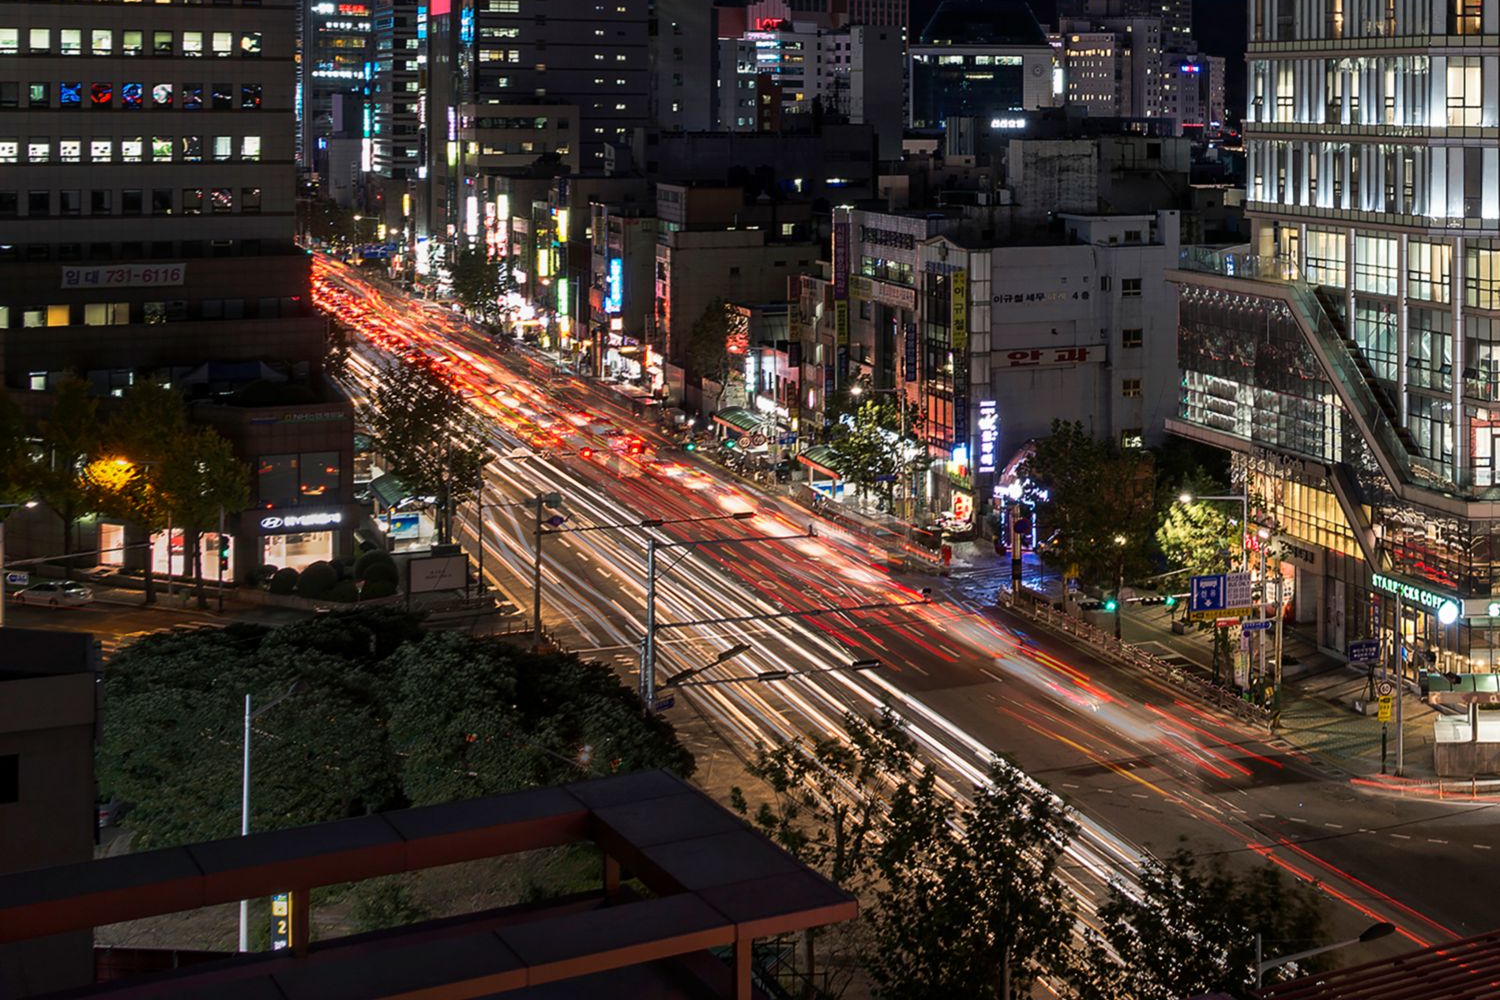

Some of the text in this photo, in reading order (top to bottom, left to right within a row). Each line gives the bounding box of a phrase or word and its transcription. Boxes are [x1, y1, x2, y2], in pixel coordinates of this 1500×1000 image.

[65, 267, 181, 285] 임대 731-6116
[1007, 347, 1091, 367] 안과
[1372, 574, 1446, 609] STARBCKS COFF
[277, 919, 288, 935] 2
